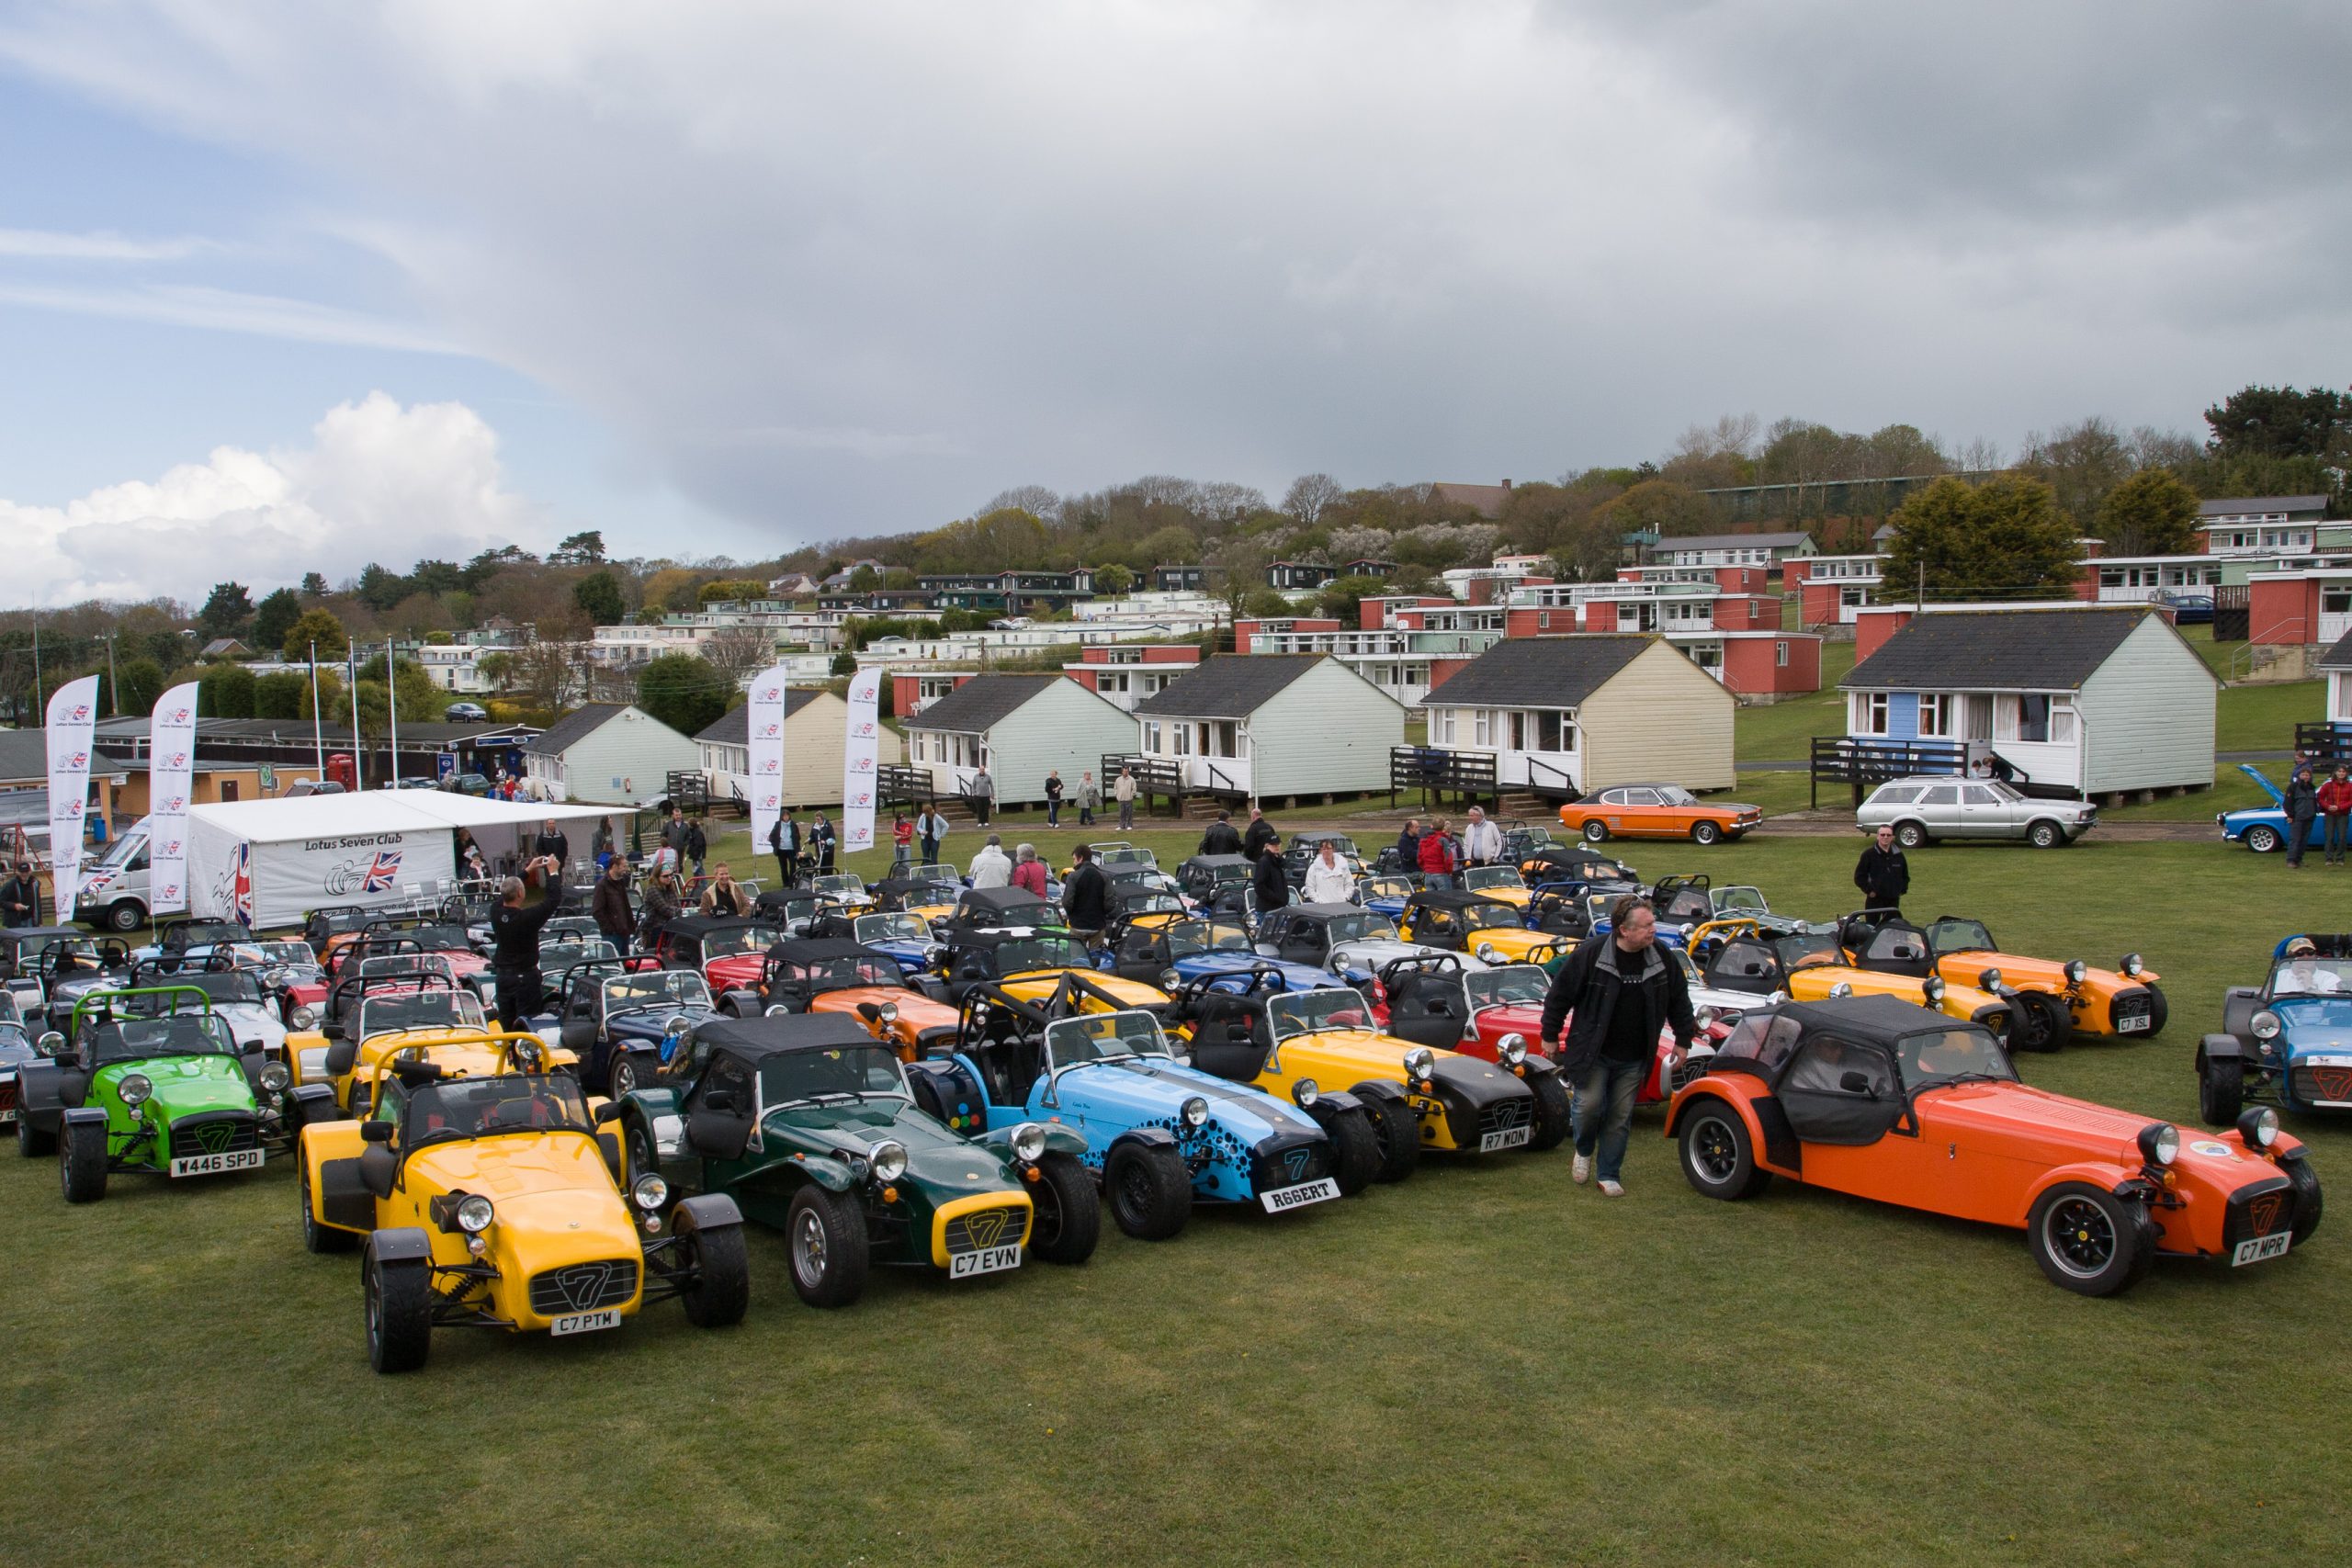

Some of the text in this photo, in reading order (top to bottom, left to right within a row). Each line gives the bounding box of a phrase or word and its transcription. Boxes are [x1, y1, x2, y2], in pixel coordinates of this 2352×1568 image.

[305, 833, 402, 852] Lotus Seven Club
[2121, 1017, 2147, 1031] C7 XSL
[1485, 1129, 1525, 1149] R7 WON
[179, 1152, 258, 1174] W446 SPD
[1284, 1148, 1310, 1181] 7
[1271, 1182, 1329, 1208] R66ERT
[2240, 1236, 2285, 1261] C7 MPR
[956, 1247, 1017, 1274] C7 EVN
[560, 1312, 612, 1332] C7 PTM
